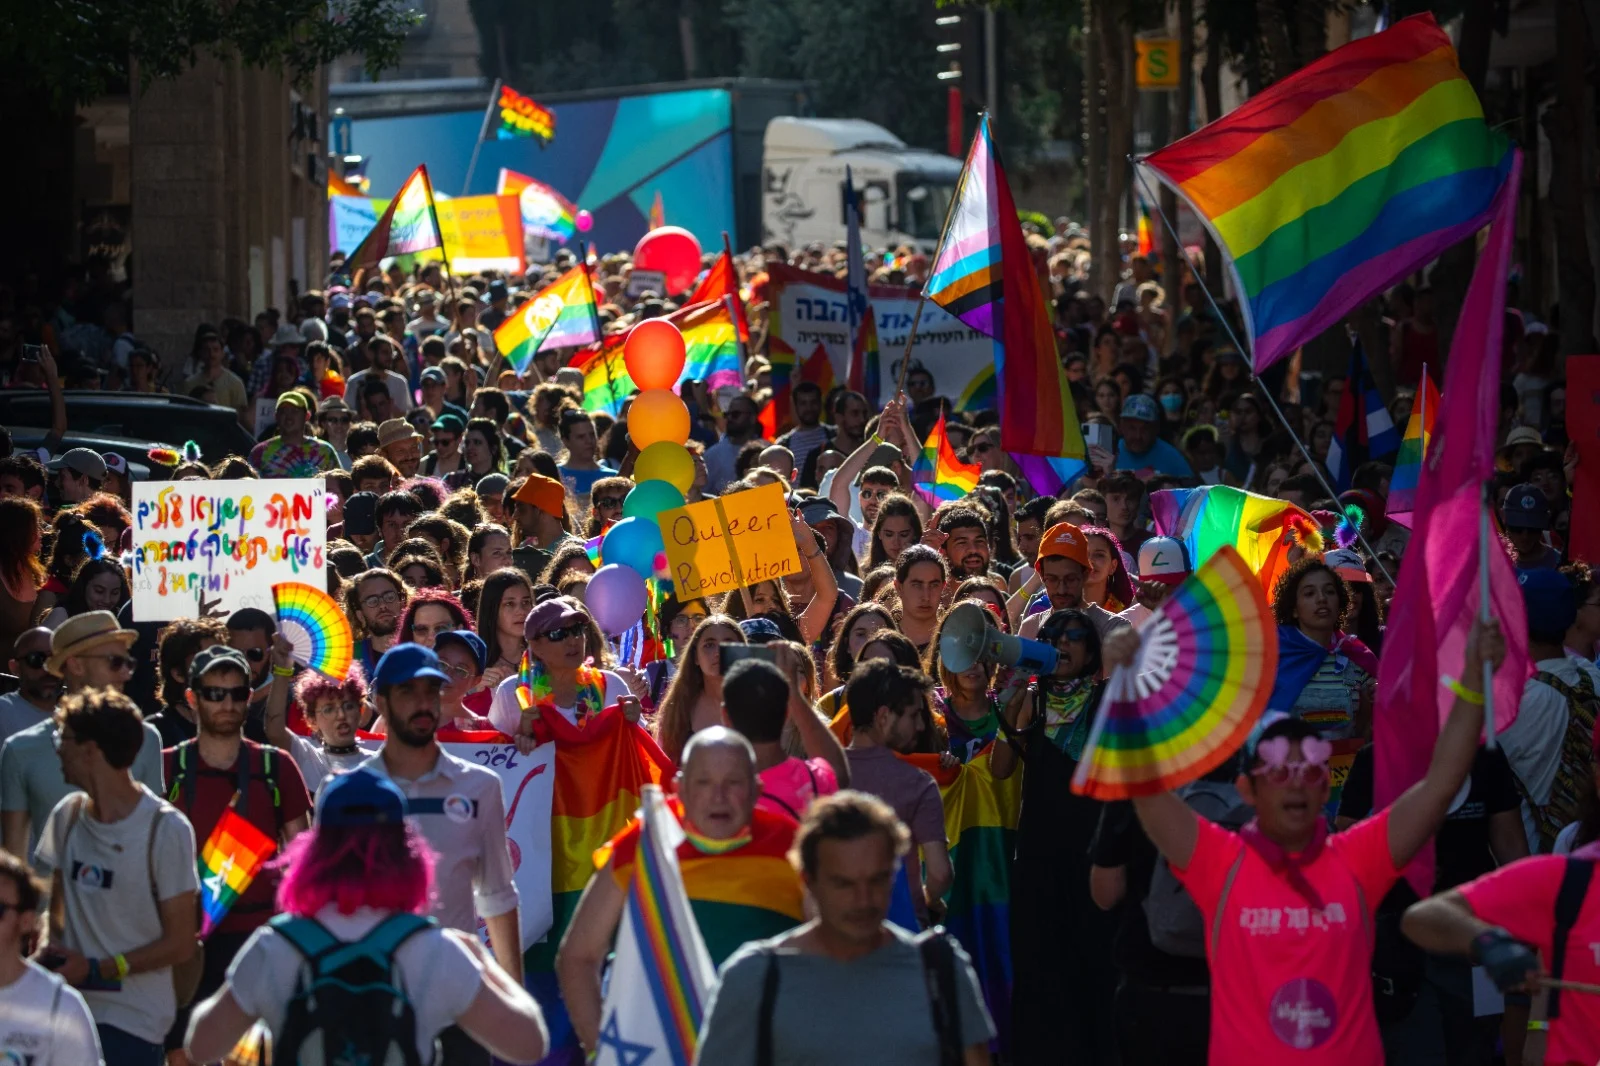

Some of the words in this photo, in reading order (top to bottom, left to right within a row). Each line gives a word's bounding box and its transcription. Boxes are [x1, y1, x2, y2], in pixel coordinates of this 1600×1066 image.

[1148, 48, 1168, 78] S
[672, 513, 779, 546] Queer
[676, 552, 792, 596] Revolution
